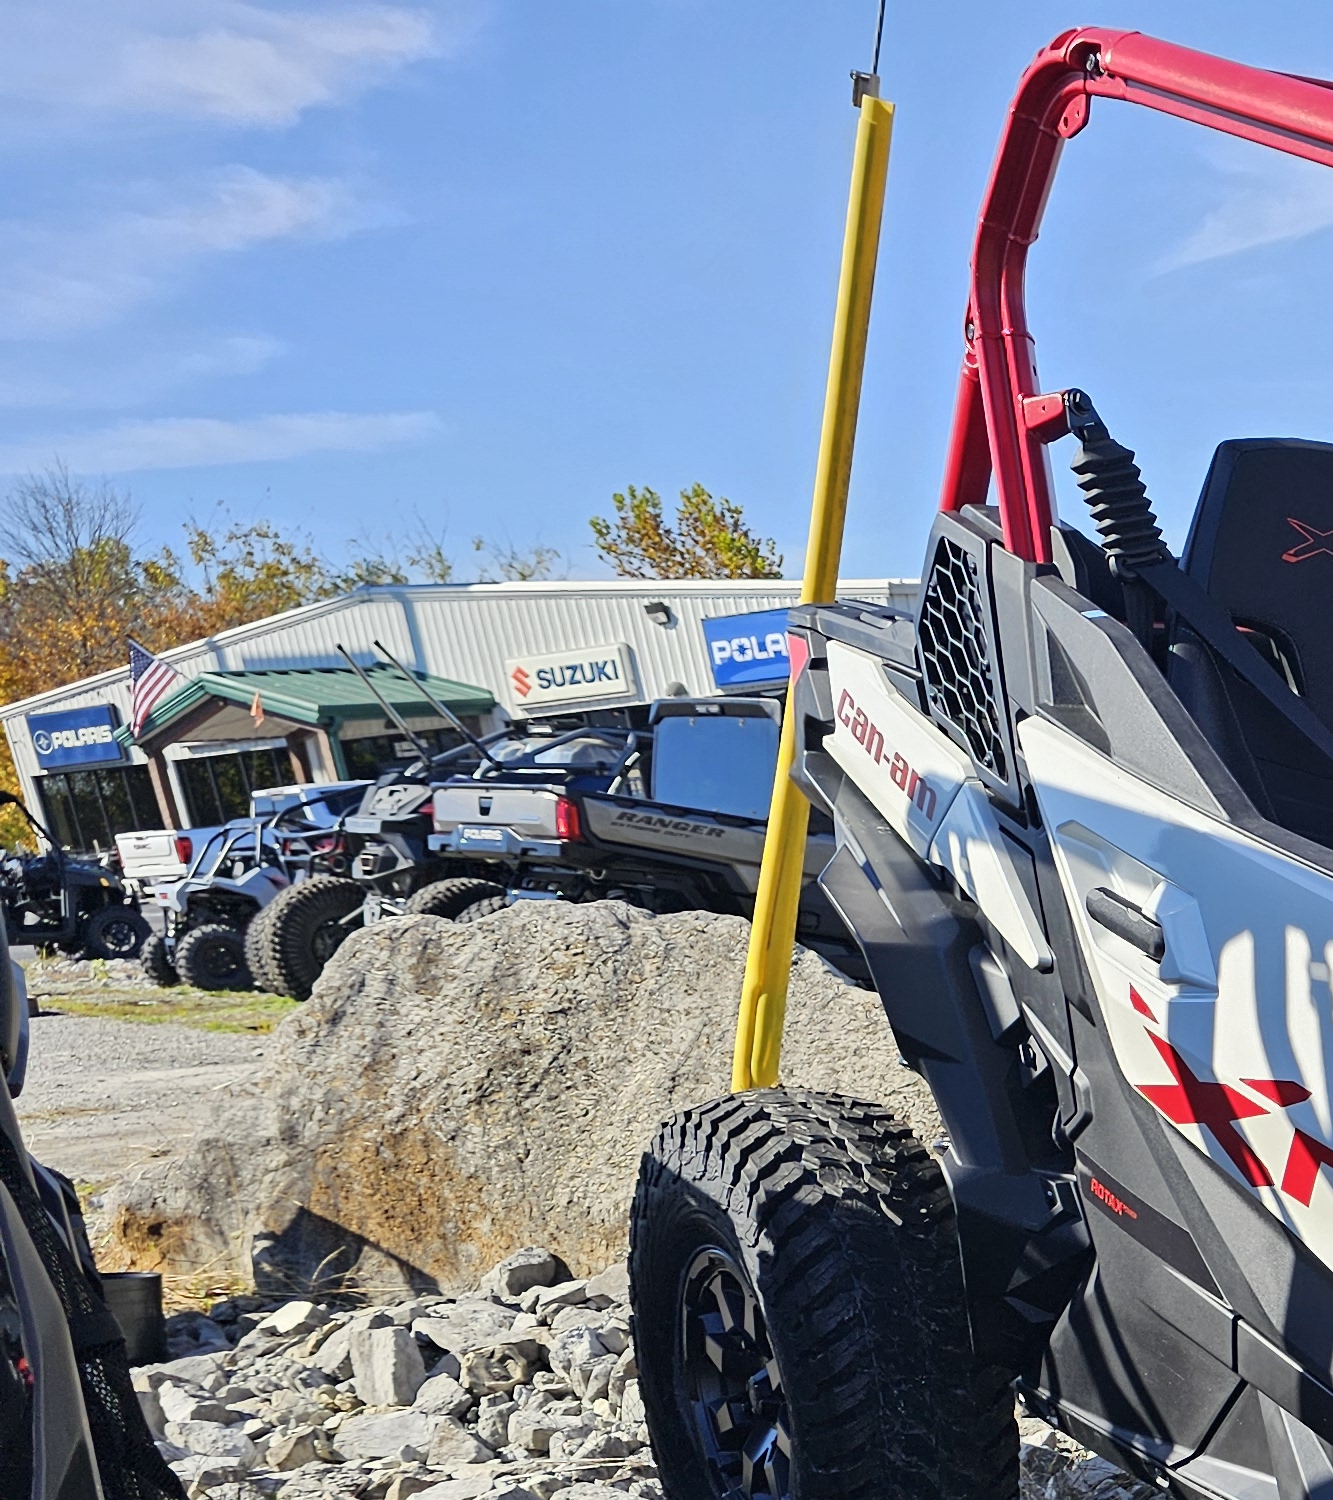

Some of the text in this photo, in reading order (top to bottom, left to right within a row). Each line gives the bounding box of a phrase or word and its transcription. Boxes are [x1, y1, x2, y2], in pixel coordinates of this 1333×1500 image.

[711, 631, 789, 665] POLA
[536, 658, 621, 690] SUZUKI
[51, 725, 113, 750] POLARIS
[836, 688, 938, 822] can-am
[616, 812, 726, 838] RANGER
[1090, 1177, 1124, 1216] ROTAX
